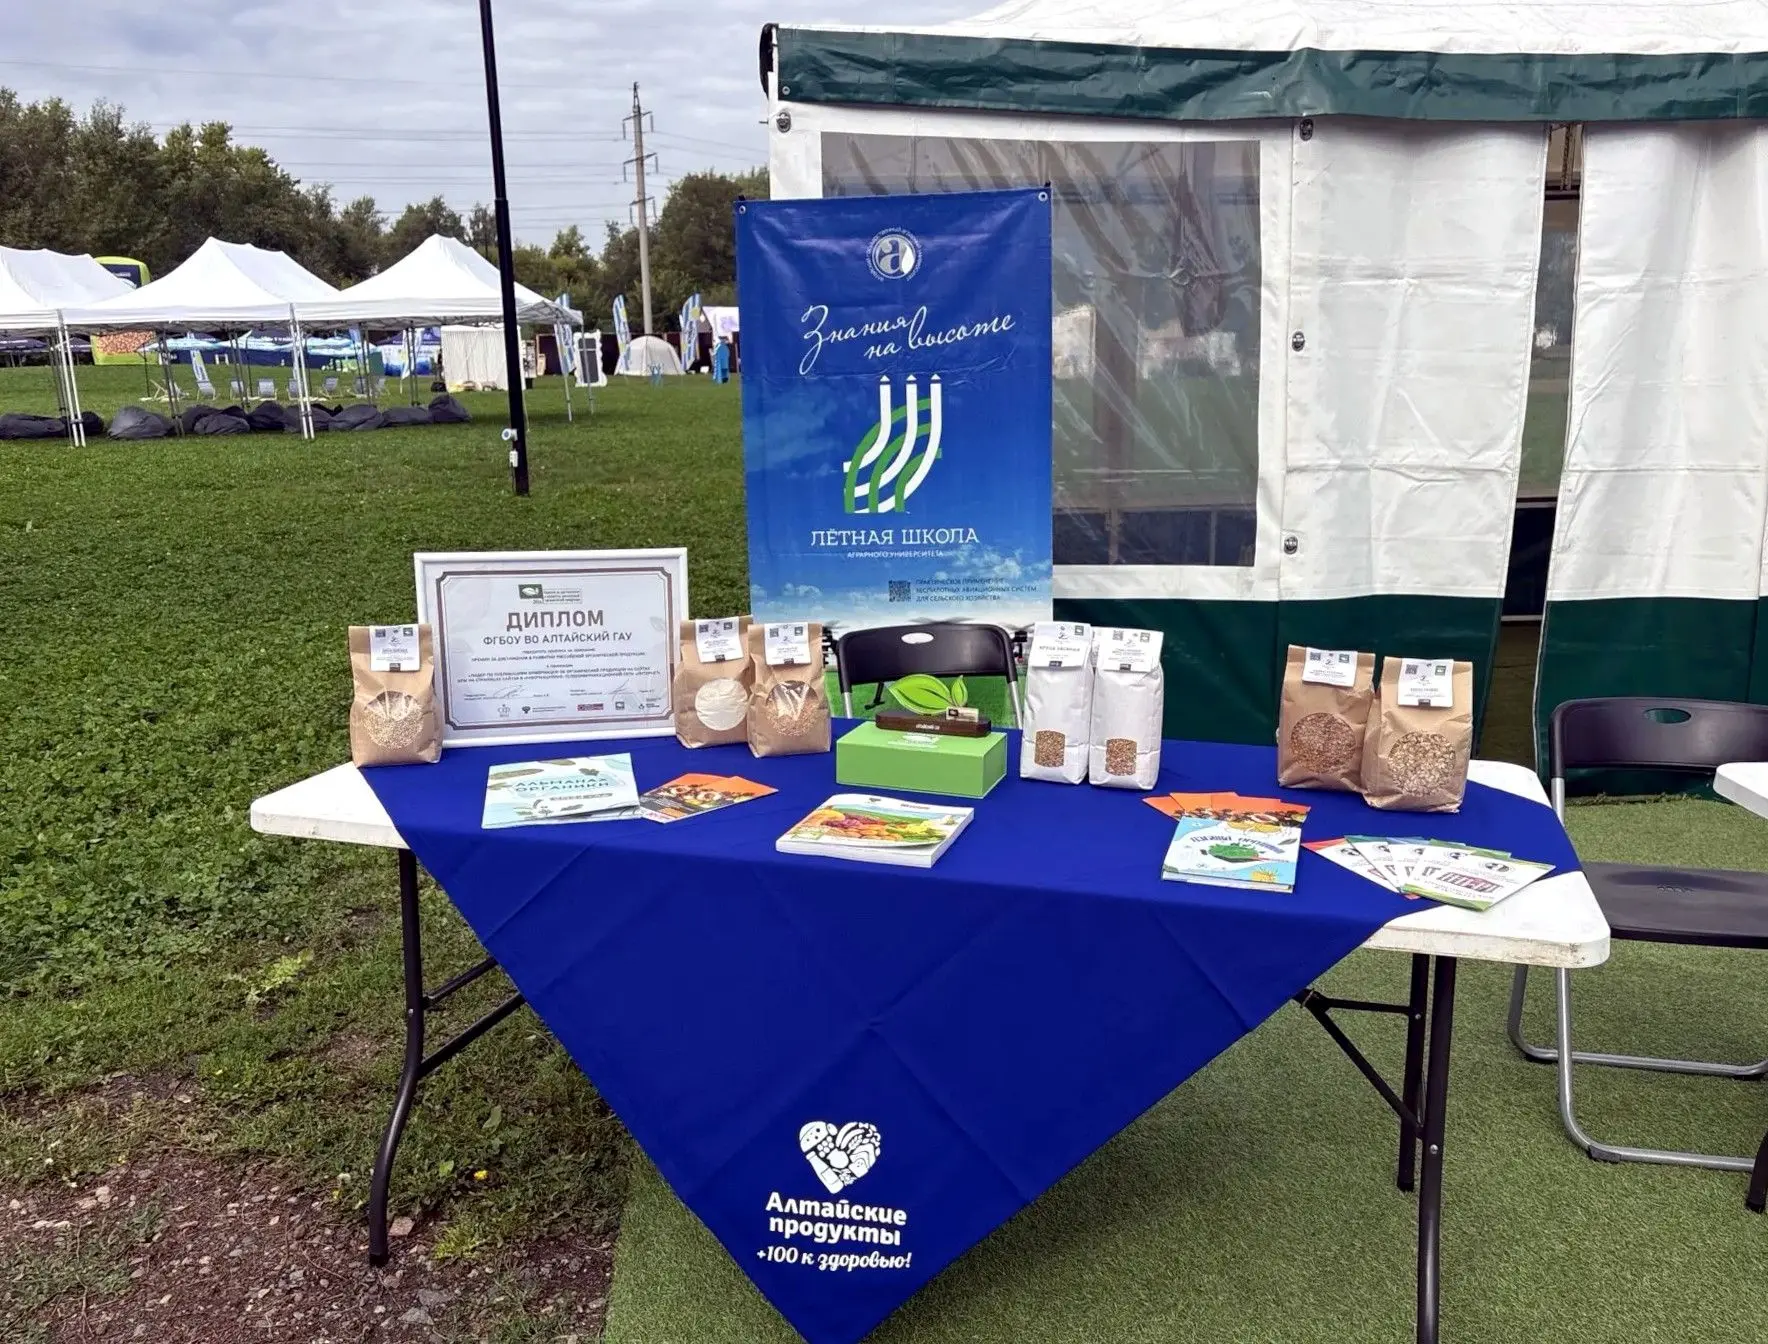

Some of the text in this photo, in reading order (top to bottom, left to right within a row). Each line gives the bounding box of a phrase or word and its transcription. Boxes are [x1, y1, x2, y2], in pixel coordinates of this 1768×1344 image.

[800, 304, 912, 375] Знания
[864, 305, 1016, 360] на высоте
[811, 527, 980, 546] ЛЁТНАЯ ШКОЛА
[847, 550, 944, 559] АГРАРНОГО УНИВЕРСИТЕТА
[506, 609, 604, 632] ДИПЛОМ
[483, 631, 632, 646] ФГБОУ ВО АЛТАЙСКИЙ ГАУ
[765, 1191, 907, 1226] Алтайские
[769, 1216, 901, 1246] продукты
[757, 1246, 913, 1272] +100 к здоровью!
